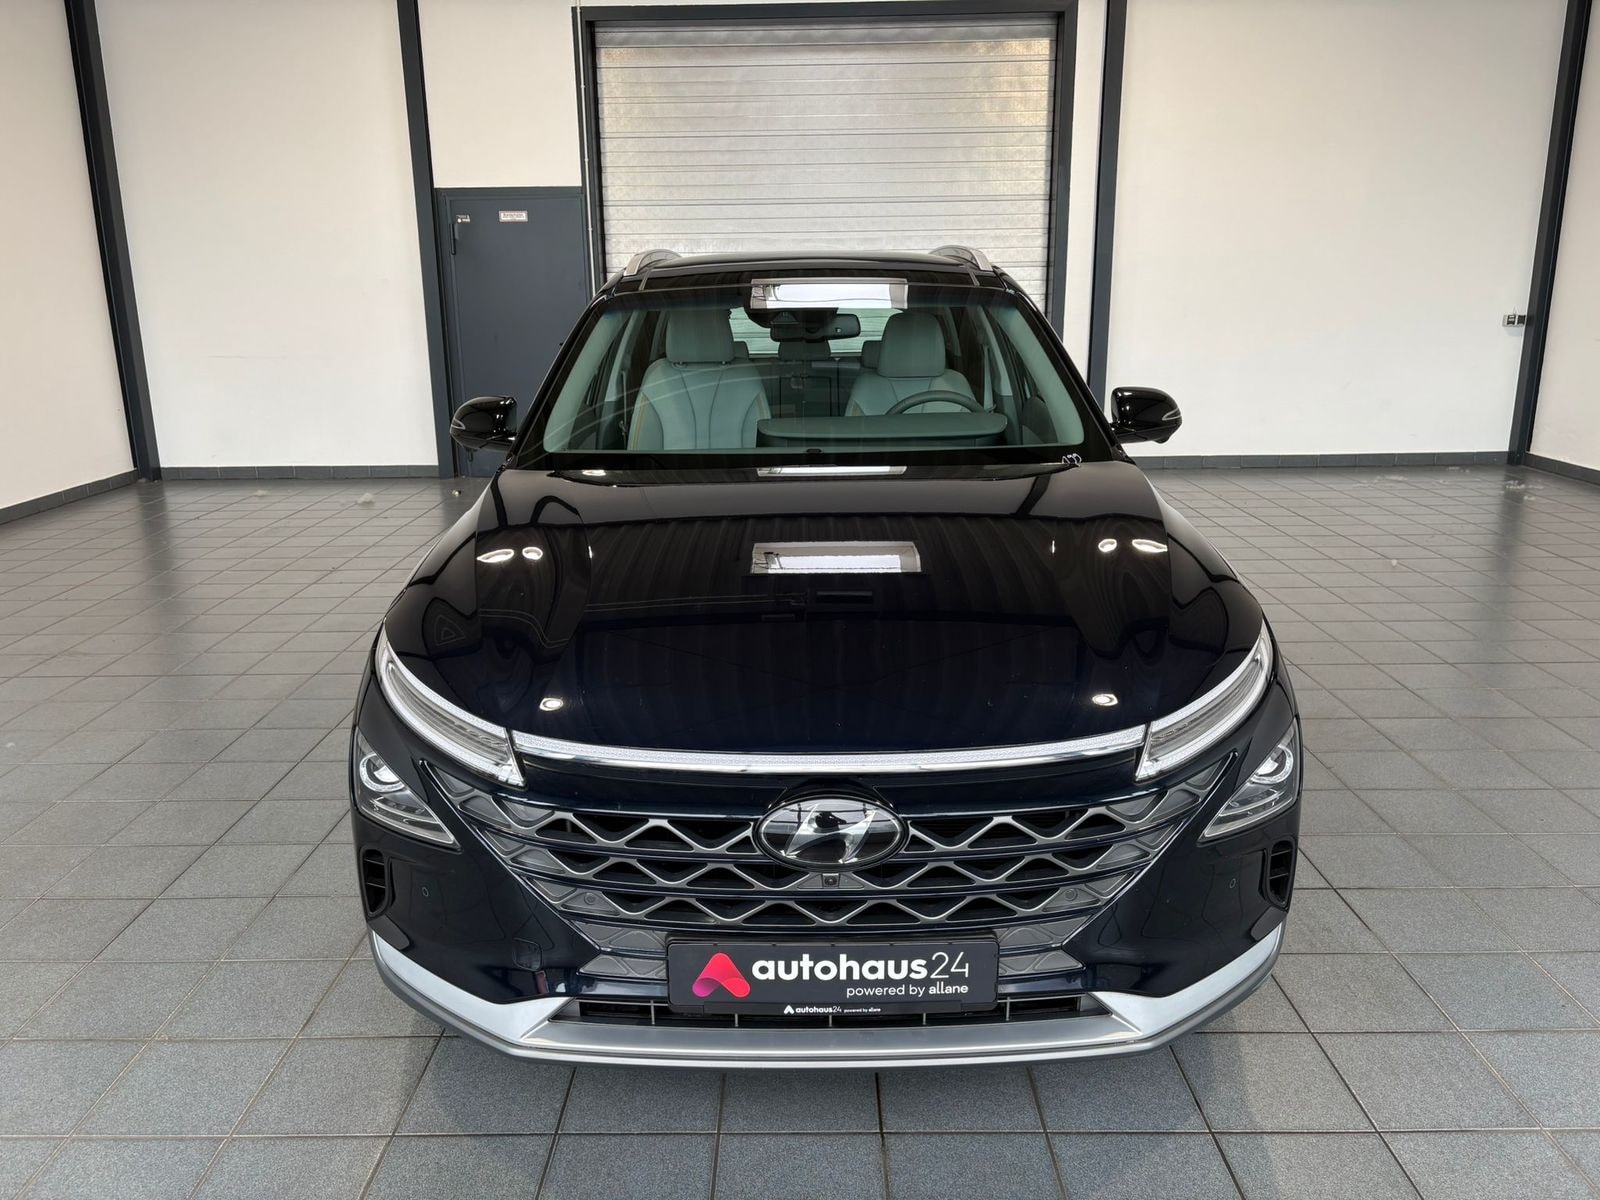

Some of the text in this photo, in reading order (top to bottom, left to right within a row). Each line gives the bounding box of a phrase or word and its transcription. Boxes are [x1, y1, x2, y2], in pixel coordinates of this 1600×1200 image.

[751, 951, 969, 981] autohaus24
[846, 981, 969, 998] powered by allane
